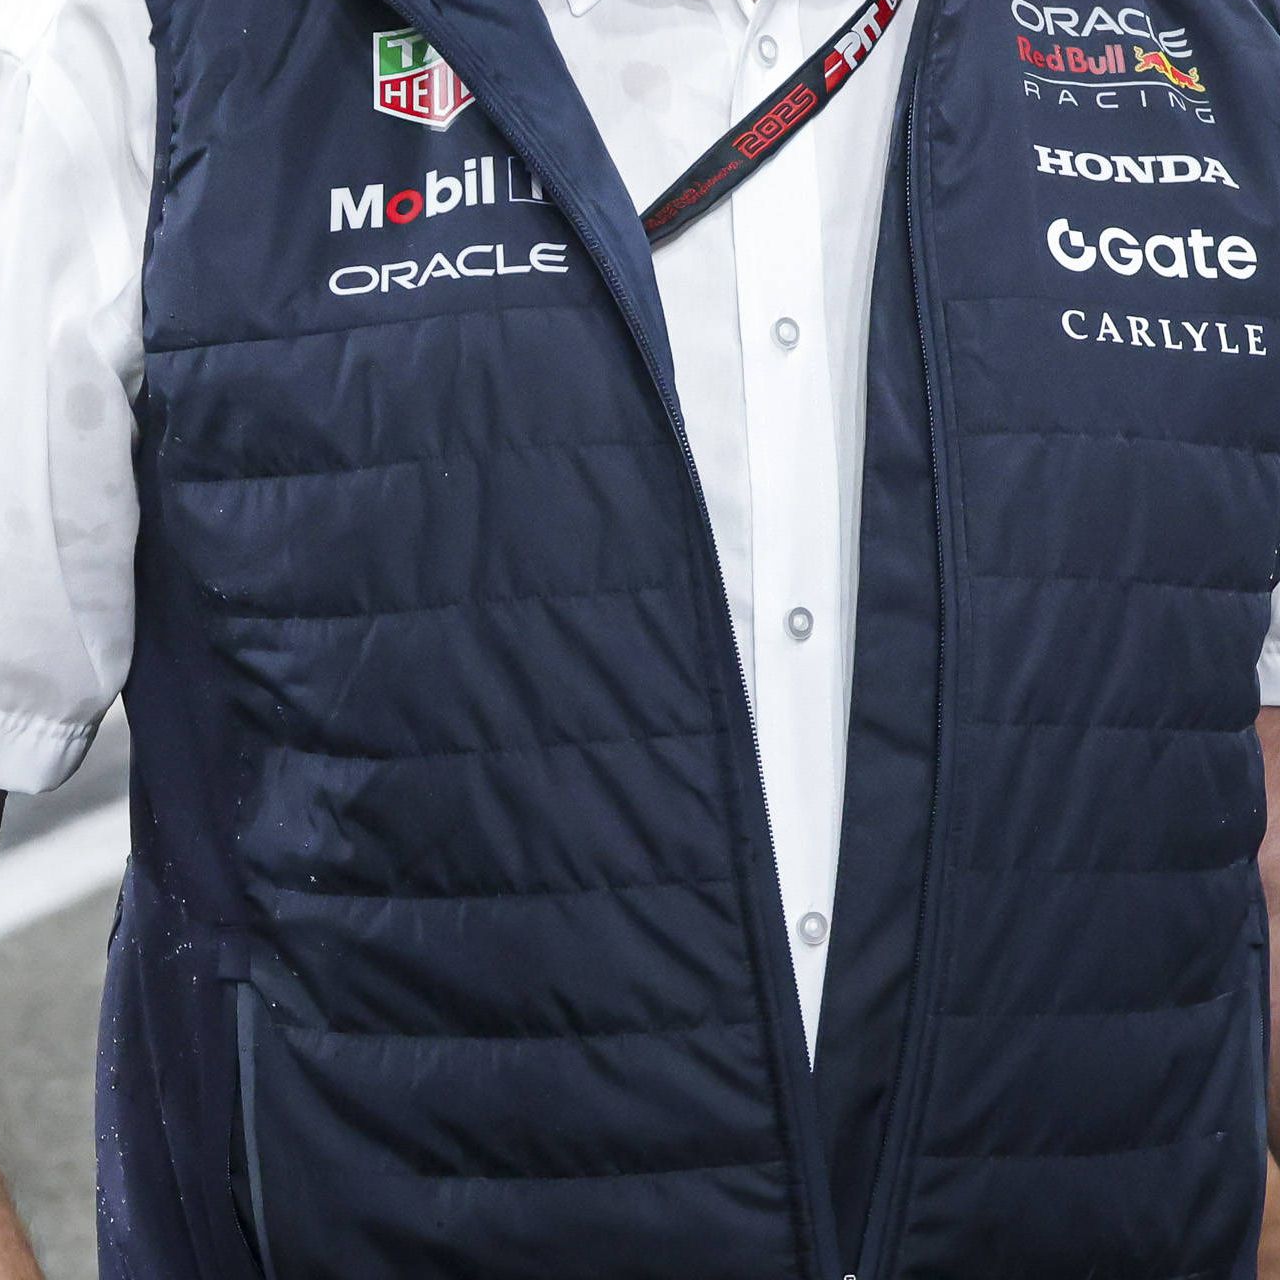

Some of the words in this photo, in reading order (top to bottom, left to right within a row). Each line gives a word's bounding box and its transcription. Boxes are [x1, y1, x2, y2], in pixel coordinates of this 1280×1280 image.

[1016, 35, 1066, 73] Red
[1066, 44, 1126, 75] Bull
[731, 82, 818, 160] 2025
[1023, 79, 1216, 124] RACING
[1033, 144, 1240, 189] HONDA
[330, 156, 495, 232] Mobil
[328, 242, 569, 296] ORACLE
[1061, 308, 1268, 357] CARLYLE
